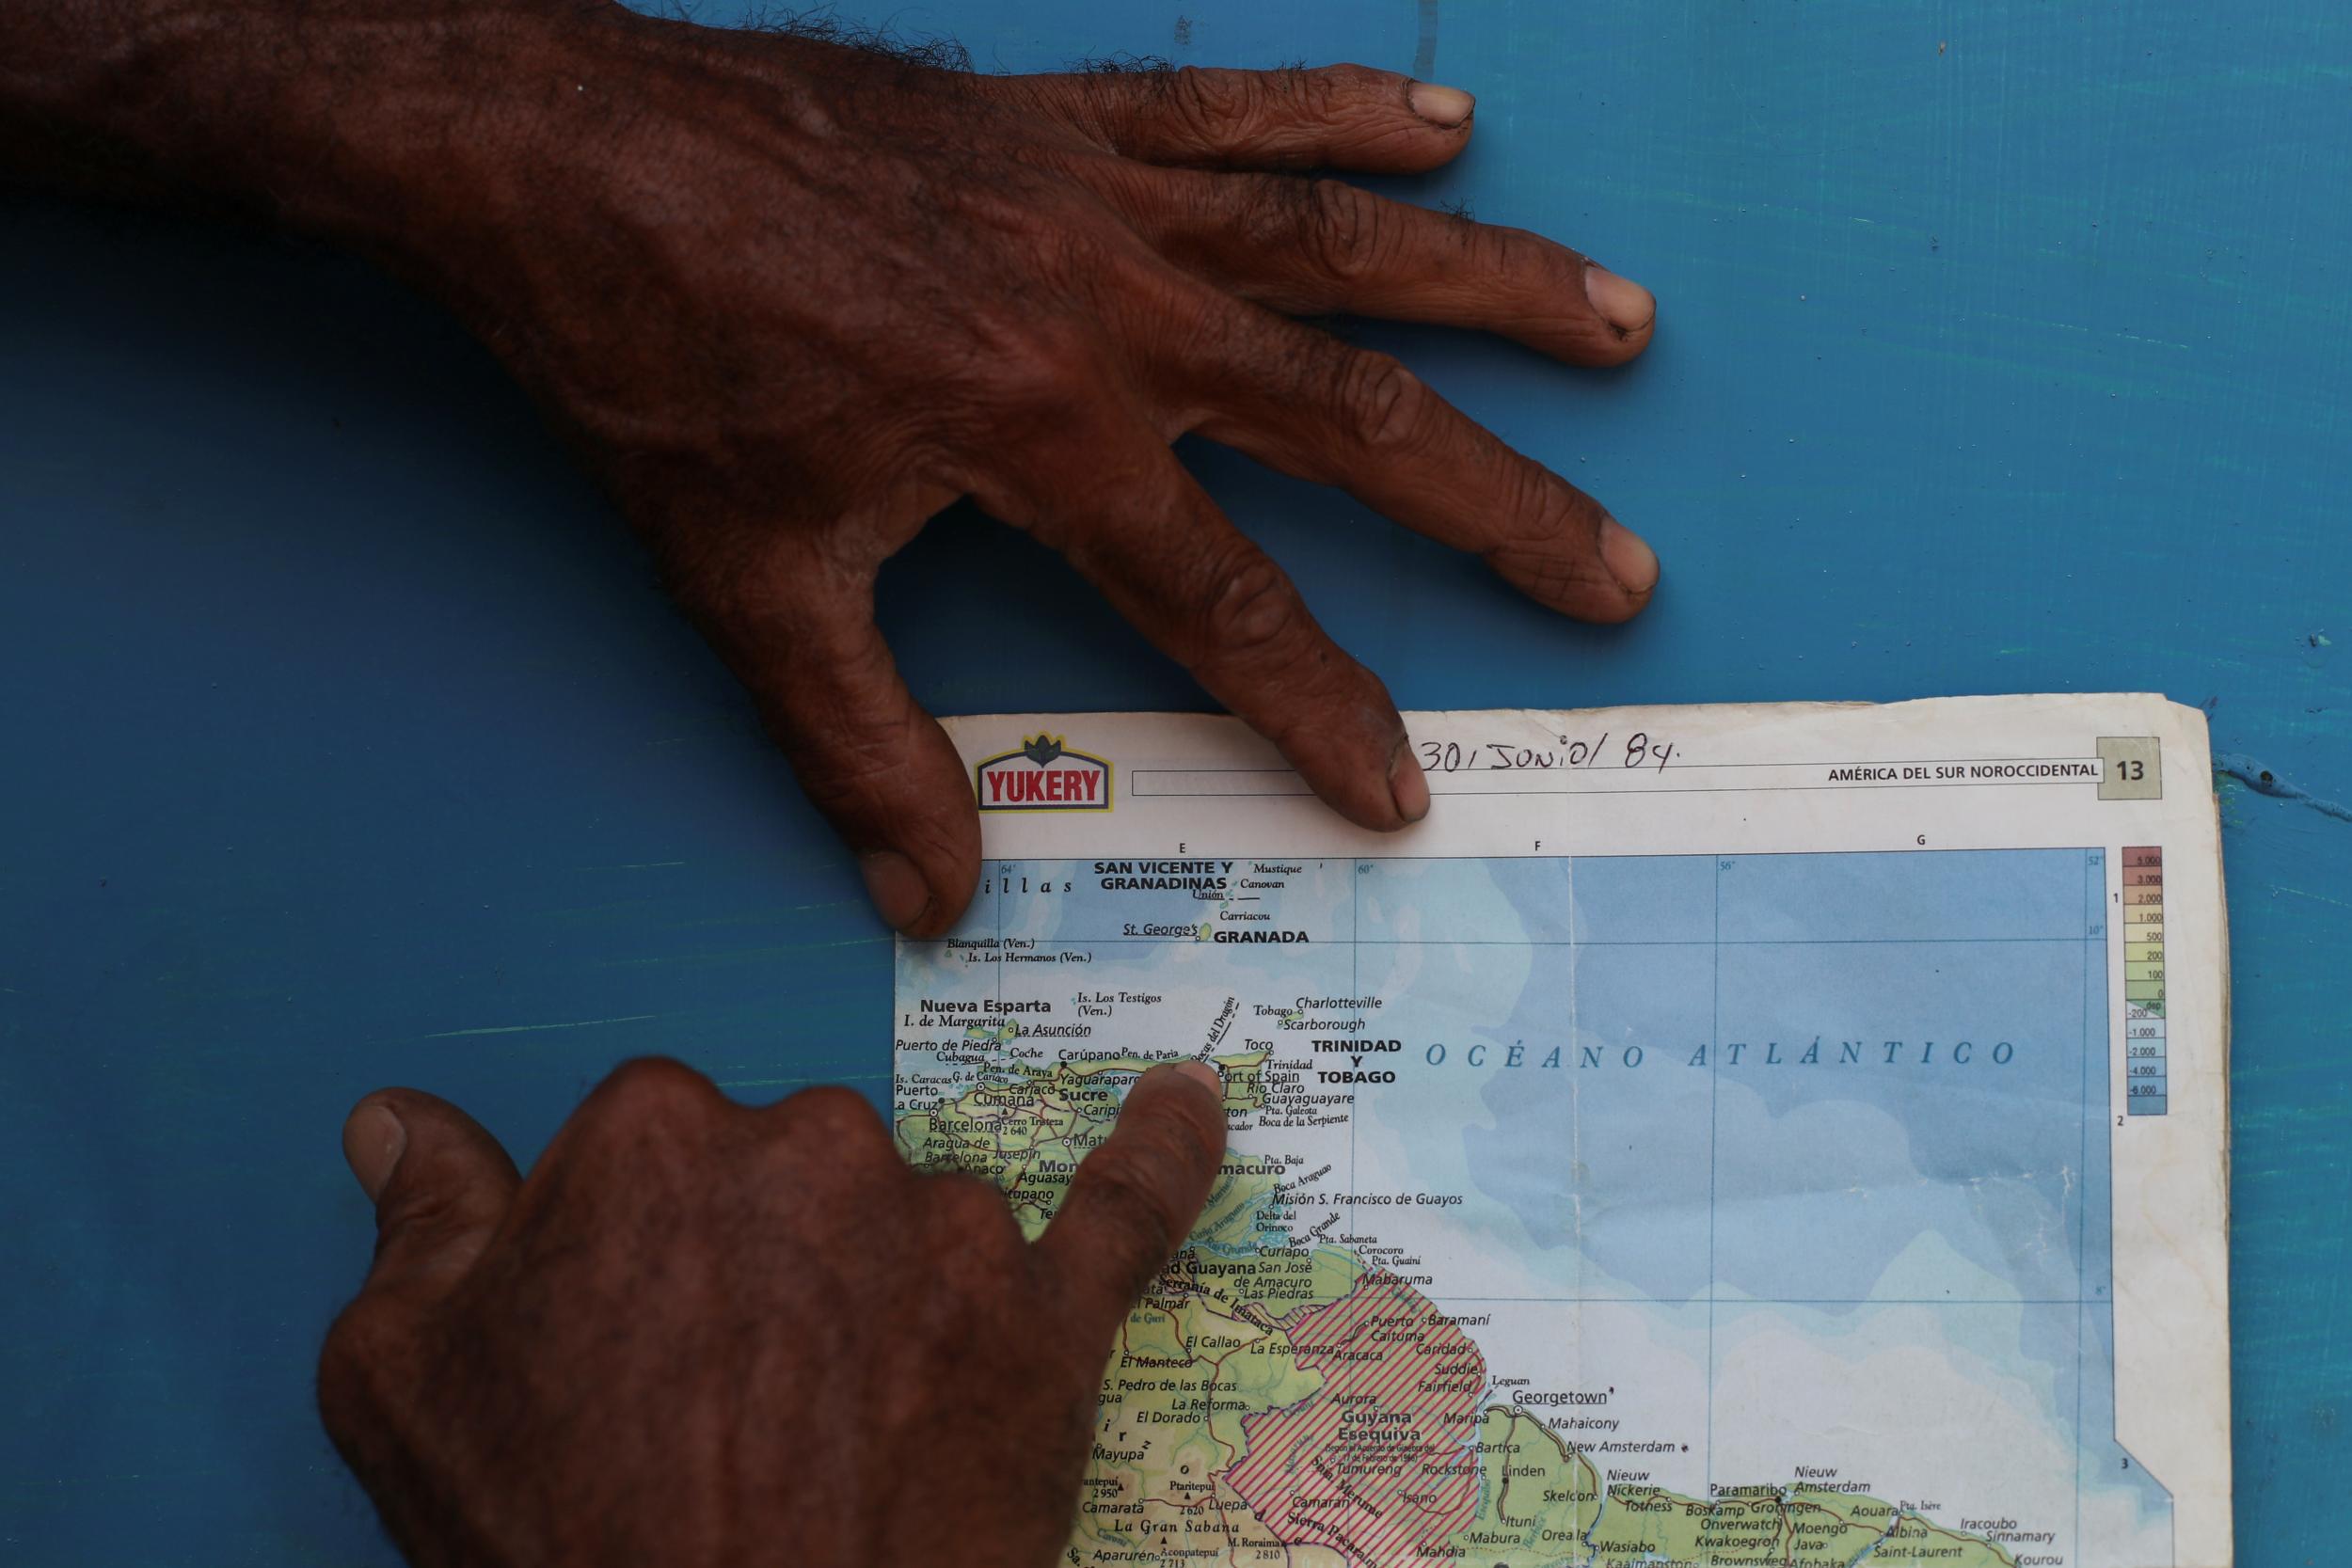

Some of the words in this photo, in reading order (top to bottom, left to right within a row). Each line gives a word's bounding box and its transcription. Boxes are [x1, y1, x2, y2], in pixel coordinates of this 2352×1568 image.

[1829, 766, 1898, 782] AMÉRICA
[1903, 767, 1931, 780] DEL
[1936, 766, 1965, 779] SUR
[1970, 763, 2099, 779] NOROCCIDENTAL
[2117, 761, 2144, 781] 13
[988, 769, 1101, 802] YUKERY
[1534, 840, 1541, 851] F
[1916, 834, 1926, 846] G
[1179, 843, 1186, 853] E
[1094, 863, 1132, 874] SAN
[1139, 862, 1215, 874] VICENTE
[1220, 862, 1232, 873] Y
[1254, 863, 1302, 876] Mustique
[1101, 878, 1227, 890] GRANADINAS
[1241, 879, 1284, 889] Canovan
[1220, 911, 1270, 921] Carriacou
[1214, 930, 1310, 943] GRANADA
[947, 938, 1000, 950] Blanquilla
[1003, 938, 1035, 949] (Ven.)
[985, 953, 1002, 962] Los
[1006, 953, 1056, 962] Hermanos
[1059, 952, 1091, 963] (Ven.)
[1095, 992, 1114, 1003] Los
[1119, 992, 1162, 1006] Testigos
[1295, 997, 1382, 1009] Charlotteville
[921, 1000, 977, 1012] Nueva
[984, 1000, 1051, 1015] Esparta
[1077, 1006, 1112, 1018] (Ven.)
[1253, 1005, 1293, 1017] Tobago
[919, 1015, 934, 1026] de
[939, 1015, 1006, 1029] Margarita
[1283, 1018, 1366, 1032] Scarborough
[1014, 1024, 1029, 1036] La
[1032, 1023, 1091, 1036] Asunción
[896, 1039, 938, 1051] Puerto
[943, 1039, 958, 1051] de
[1245, 1039, 1273, 1051] Toco
[1311, 1039, 1402, 1053] TRINIDAD
[937, 1052, 985, 1064] Cubagua
[1010, 1047, 1043, 1058] Coche
[1058, 1047, 1120, 1062] Carúpano
[1156, 1049, 1179, 1060] Paria
[1425, 1039, 1644, 1069] OCÉANO
[1687, 1036, 2013, 1067] ATLÁNTICO
[1266, 1058, 1312, 1070] Trinidad
[1350, 1055, 1362, 1068] Y
[1023, 1067, 1053, 1079] Araya
[1264, 1070, 1299, 1085] Spain
[1317, 1070, 1396, 1084] TOBAGO
[912, 1074, 952, 1085] Caracas
[896, 1085, 938, 1096] Puerto
[1059, 1088, 1107, 1101] Sucre
[1271, 1083, 1305, 1094] Claro
[909, 1099, 938, 1110] Cruz
[1263, 1093, 1355, 1109] Guayaguayare
[1286, 1105, 1317, 1117] Galeota
[930, 1118, 1001, 1132] Barcelona
[1002, 1117, 1026, 1126] Cerro
[1259, 1116, 1280, 1127] Boca
[1308, 1115, 1348, 1127] Serpiente
[2117, 1116, 2123, 1126] 2
[923, 1137, 968, 1150] Aragua
[975, 1136, 990, 1148] de
[1285, 1155, 1304, 1166] Baja
[1272, 1193, 1314, 1205] Misión
[1333, 1193, 1391, 1204] Francisco
[1396, 1194, 1412, 1205] de
[1416, 1194, 1463, 1207] Guayos
[1256, 1210, 1280, 1220] Delta
[1283, 1210, 1296, 1220] del
[1256, 1222, 1294, 1232] Orinoco
[1340, 1234, 1377, 1244] Sabaneta
[1260, 1246, 1310, 1259] Curiapo
[1359, 1244, 1404, 1255] Corocoro
[1186, 1261, 1256, 1277] Guayana
[1259, 1262, 1284, 1274] San
[1233, 1277, 1249, 1288] de
[1253, 1277, 1312, 1288] Amacuro
[1362, 1273, 1433, 1285] Mabaruma
[1244, 1288, 1263, 1299] Las
[1267, 1287, 1313, 1299] Piedras
[1371, 1317, 1413, 1327] Puerto
[1201, 1337, 1240, 1348] Callao
[1416, 1343, 1466, 1354] Caridad
[1251, 1343, 1265, 1354] La
[1269, 1343, 1334, 1356] Esperanza
[1435, 1364, 1478, 1375] Suddie
[1118, 1380, 1155, 1391] Pedro
[1160, 1380, 1175, 1391] de
[1180, 1380, 1197, 1391] las
[1200, 1380, 1237, 1391] Bocas
[1418, 1382, 1471, 1392] Fairfield
[1492, 1375, 1530, 1387] Leguan
[1331, 1394, 1376, 1404] Aurora
[1513, 1390, 1607, 1406] Georgetown
[1171, 1399, 1185, 1410] La
[1190, 1399, 1245, 1410] Reforma
[1152, 1412, 1200, 1423] Dorado
[1342, 1411, 1411, 1426] Guyana
[1549, 1418, 1619, 1432] Mahaicony
[1475, 1442, 1520, 1453] Bartica
[1567, 1441, 1596, 1453] New
[1599, 1441, 1675, 1453] Amsterdam
[1502, 1465, 1545, 1477] Linden
[1607, 1469, 1650, 1481] Nieuw
[1794, 1466, 1837, 1479] Nieuw
[1607, 1484, 1661, 1497] Nickerie
[1709, 1482, 1787, 1497] Paramaribo
[1795, 1481, 1871, 1494] Amsterdam
[1686, 1505, 1745, 1518] Boskamp
[1851, 1506, 1898, 1517] Aouara
[1141, 1519, 1178, 1535] Gran
[1185, 1519, 1239, 1533] Sabana
[1505, 1515, 1536, 1528] Ituni
[1961, 1517, 2017, 1529] Iracoubo
[1792, 1523, 1848, 1536] Moengo
[1886, 1527, 1928, 1538] Albina
[1242, 1538, 1279, 1547] Roraima
[1470, 1531, 1520, 1544] Mabura
[1695, 1535, 1779, 1550] Kwakoegron
[1986, 1530, 2055, 1544] Sinnamary
[1600, 1541, 1655, 1553] Wasiabo
[1794, 1539, 1823, 1551] Java
[1874, 1545, 1963, 1558] Saint-Laurent
[2015, 1554, 2063, 1566] Kourou
